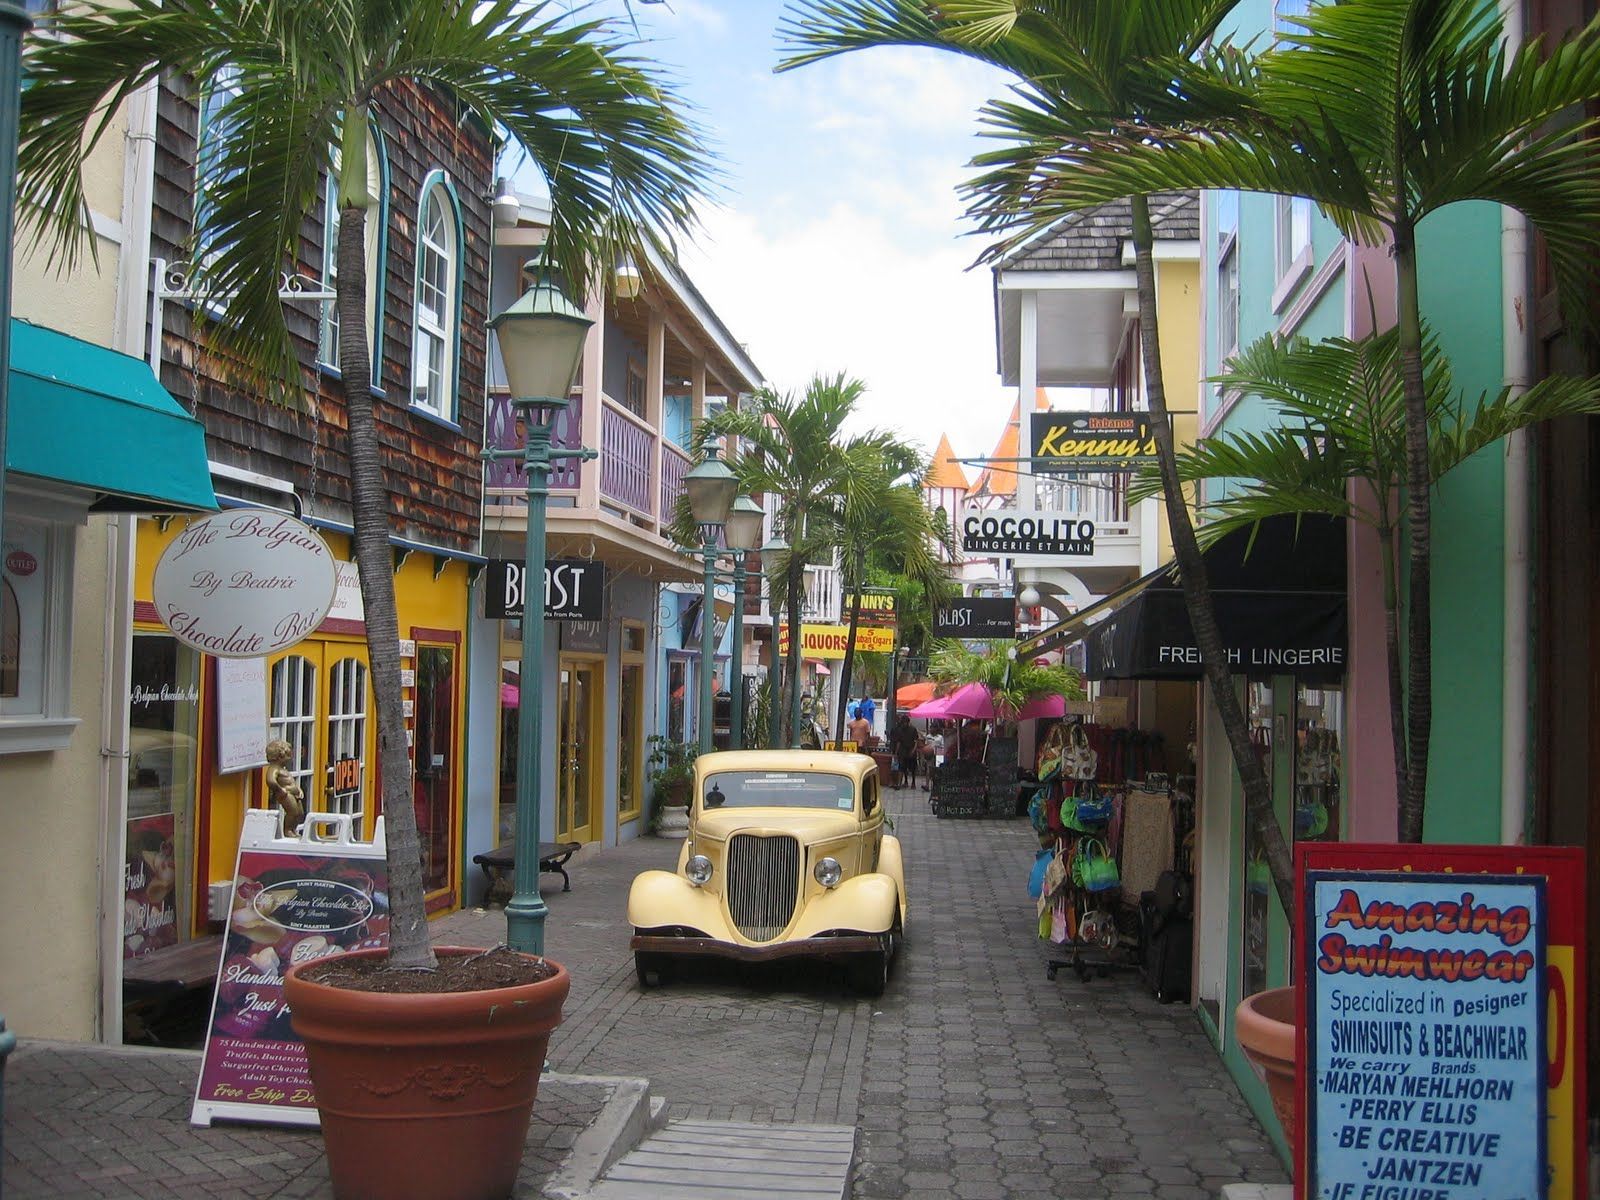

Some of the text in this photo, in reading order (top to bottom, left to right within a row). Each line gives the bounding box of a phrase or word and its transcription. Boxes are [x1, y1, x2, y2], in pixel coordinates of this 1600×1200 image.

[1089, 418, 1134, 428] Habanos
[1037, 424, 1157, 457] Kenny's
[173, 515, 323, 561] The Belgian
[964, 516, 1095, 541] COCOLITO
[967, 540, 1091, 552] LINGERIE ET BAIN
[190, 570, 297, 597] By Beatrix
[504, 610, 523, 618] Clothe
[846, 594, 894, 610] KNNY'S
[167, 603, 319, 653] Chocolate Box
[939, 608, 972, 627] BLAST
[801, 633, 848, 650] IQUORS
[1159, 646, 1343, 664] FREH LINGERIE
[133, 685, 159, 708] Belgian
[336, 759, 359, 791] OPEN
[1325, 889, 1531, 946] Amazing
[1318, 933, 1535, 983] Swimwear
[238, 991, 277, 1016] Just
[1331, 990, 1528, 1017] Specialized in Designer
[231, 1039, 282, 1050] Handmade
[1331, 1020, 1528, 1060] SWIMSUITS & BEACHWEAR
[239, 1072, 267, 1081] Adult
[268, 1074, 285, 1084] Toy
[1330, 1058, 1476, 1075] We carry Brands
[213, 1083, 244, 1098] Free
[247, 1086, 285, 1104] Ship
[1324, 1071, 1514, 1101] MARYAN MEHLHORN
[1349, 1099, 1478, 1125] PERRY ELLIS
[1338, 1125, 1500, 1157] BE CREATIVE
[1366, 1157, 1483, 1186] JANTZEN
